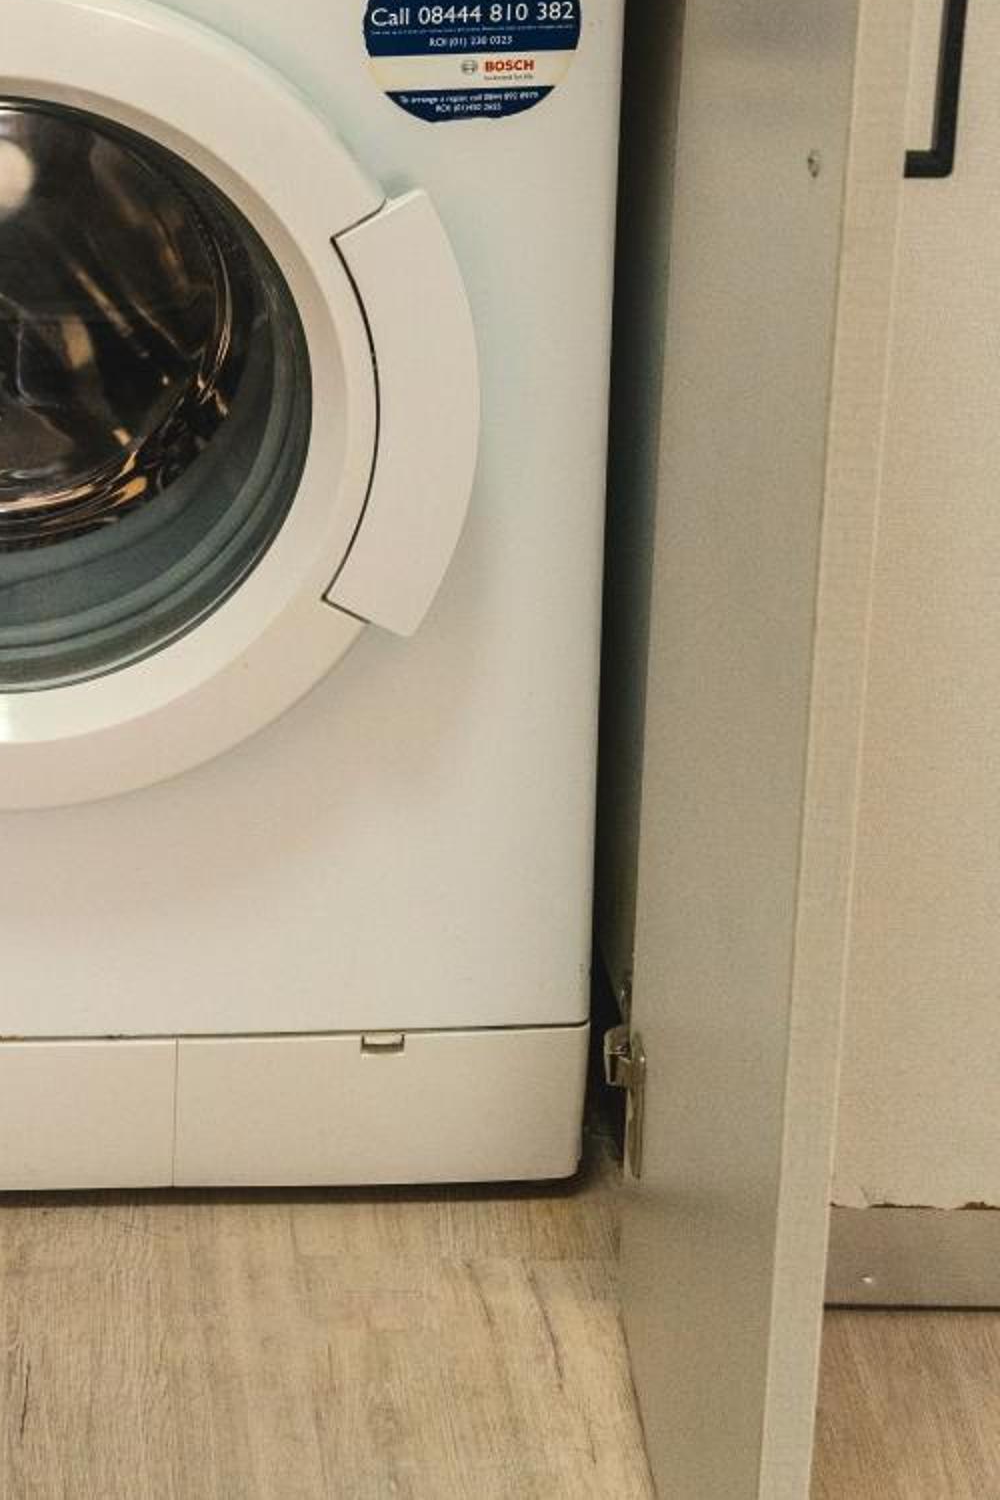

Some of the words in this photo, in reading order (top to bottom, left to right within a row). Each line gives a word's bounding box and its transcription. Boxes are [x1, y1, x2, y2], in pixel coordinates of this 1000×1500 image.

[371, 7, 410, 27] Call
[417, 4, 482, 25] 08444
[489, 3, 529, 22] 810
[536, 1, 575, 20] 382
[484, 58, 535, 73] BOSCH
